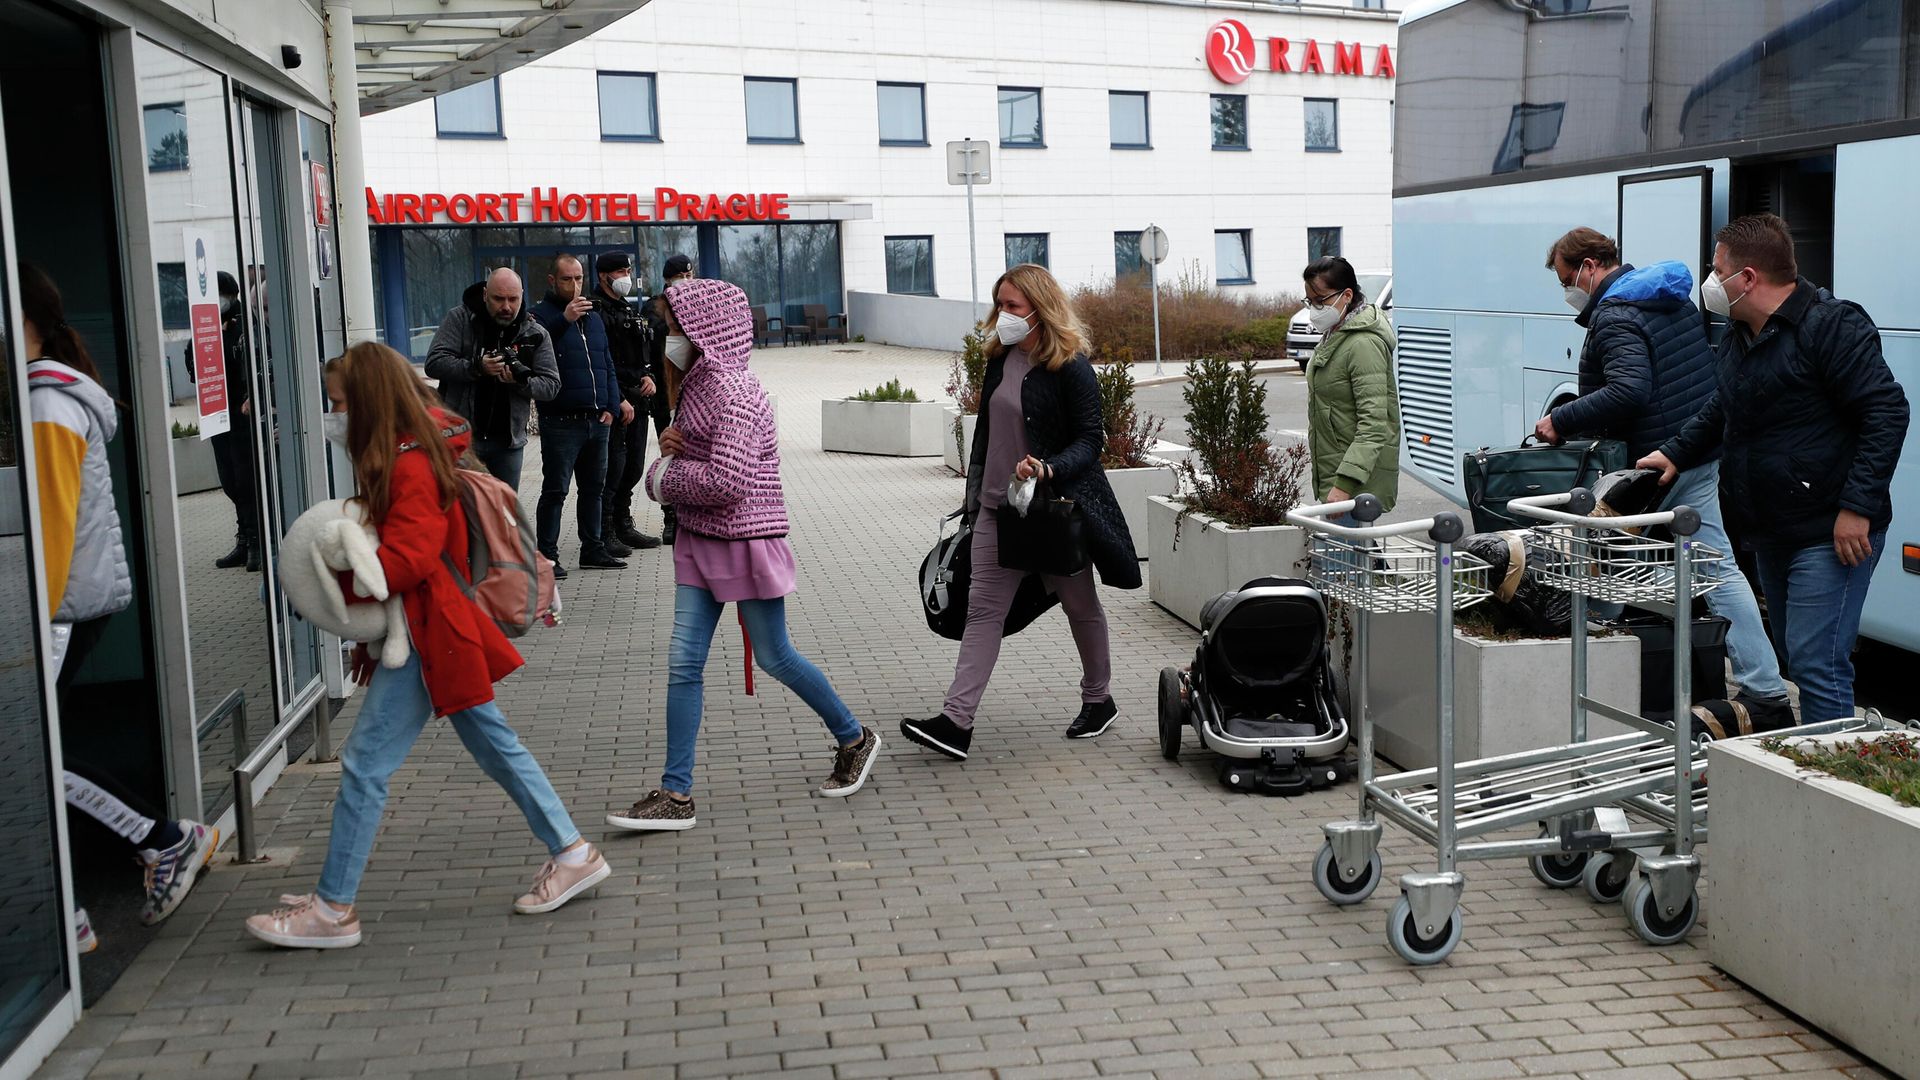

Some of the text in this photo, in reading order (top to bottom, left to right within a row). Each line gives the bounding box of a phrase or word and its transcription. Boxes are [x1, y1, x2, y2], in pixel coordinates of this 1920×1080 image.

[1268, 36, 1395, 79] RAMA
[365, 187, 524, 223] AIRPORT
[531, 187, 650, 222] HOTEL
[655, 187, 790, 221] PRAGUE
[684, 292, 700, 302] SUN
[701, 286, 717, 296] FUN
[717, 283, 732, 292] RUN
[707, 294, 723, 303] SUN
[690, 299, 706, 308] FUN
[698, 305, 714, 315] FUN
[715, 300, 731, 309] RUN
[732, 296, 746, 304] SUN
[723, 307, 738, 316] RUN
[732, 312, 746, 321] SUN
[735, 410, 752, 421] SUN
[718, 414, 752, 430] FUN RUN
[720, 424, 737, 434] SUN
[724, 461, 740, 473] SUN
[714, 466, 747, 486] RUN SUN
[715, 475, 747, 496] FUN RUN
[737, 506, 754, 514] SUN
